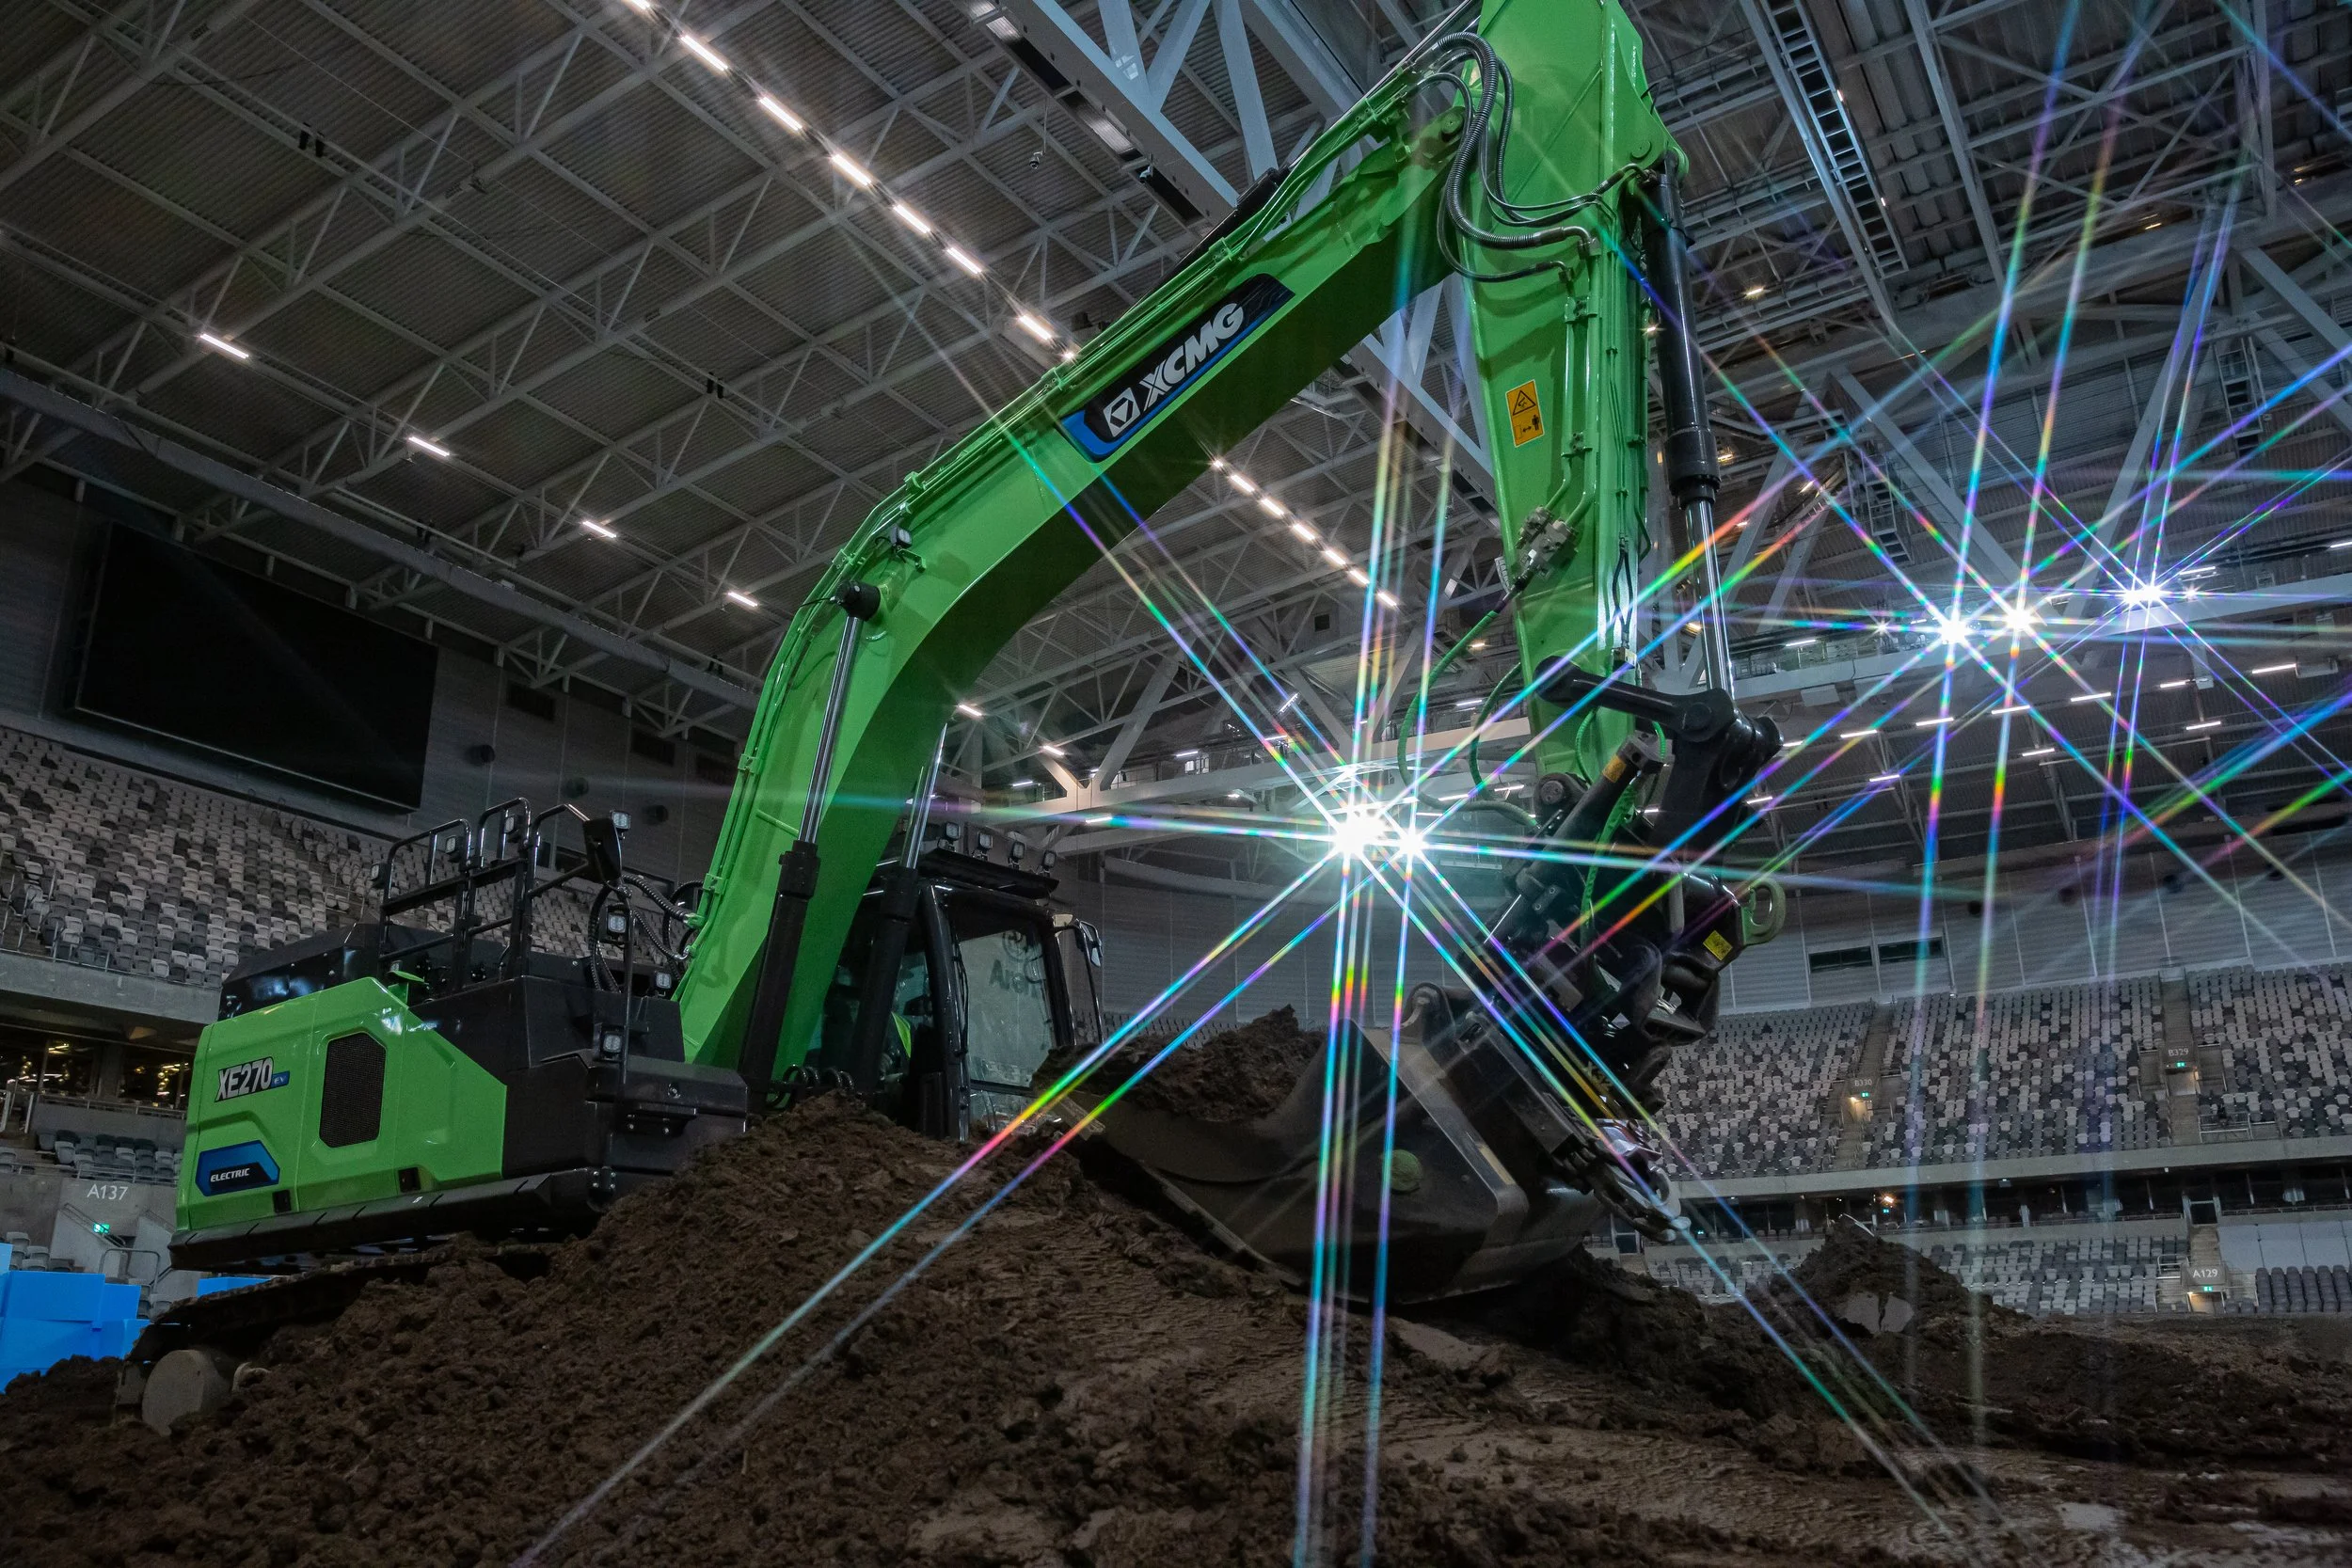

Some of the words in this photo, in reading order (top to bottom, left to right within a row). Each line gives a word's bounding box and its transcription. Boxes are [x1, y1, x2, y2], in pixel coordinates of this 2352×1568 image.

[1139, 303, 1244, 412] XCMG
[215, 1057, 273, 1101] XE270
[210, 1167, 250, 1182] ELECTRIC
[87, 1183, 129, 1200] A137
[2192, 1268, 2218, 1278] A129
